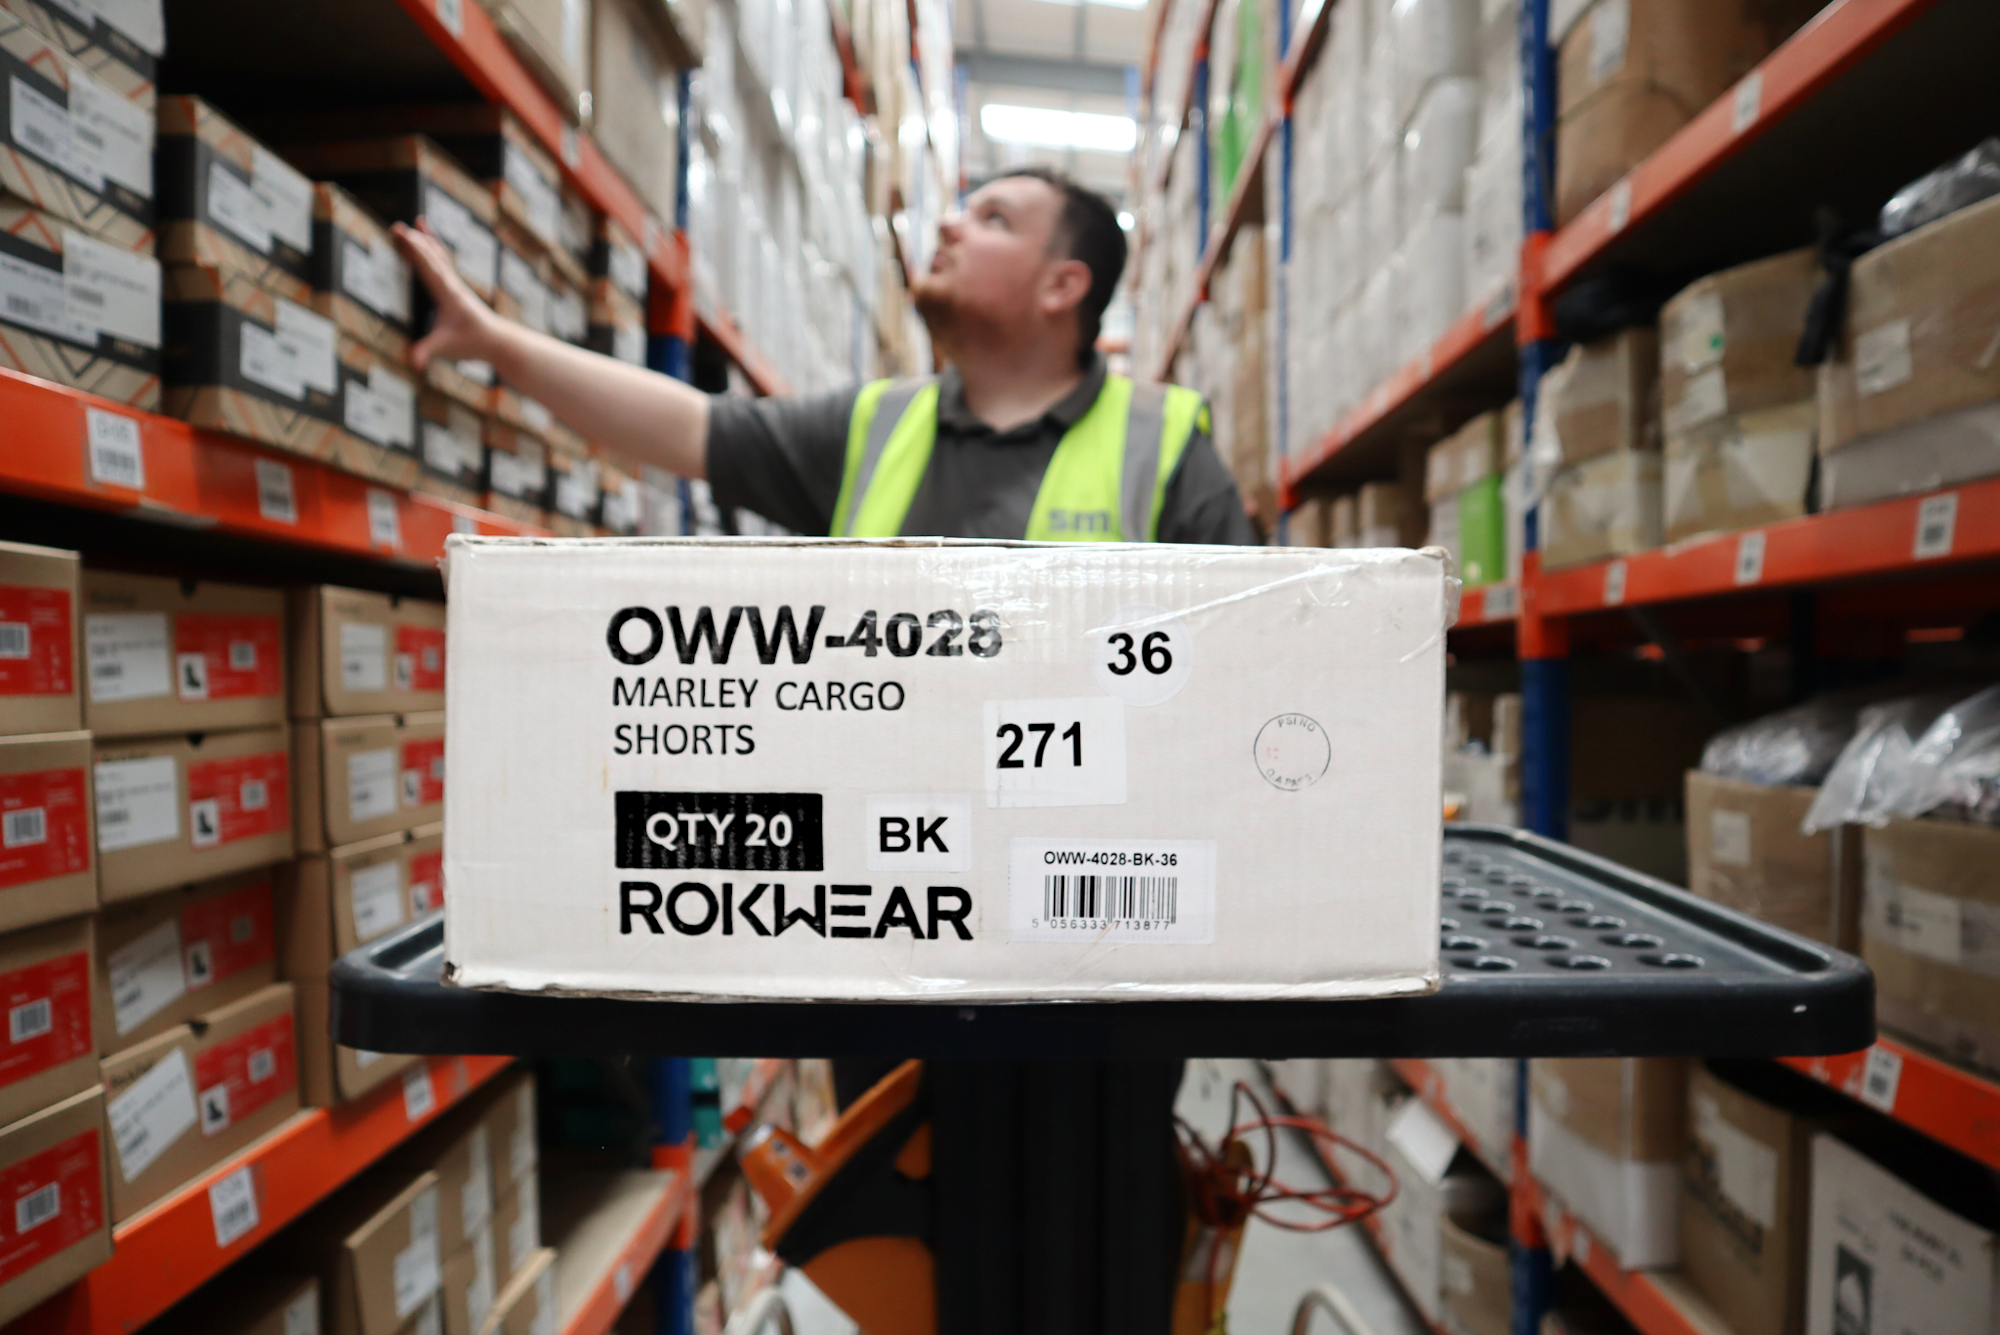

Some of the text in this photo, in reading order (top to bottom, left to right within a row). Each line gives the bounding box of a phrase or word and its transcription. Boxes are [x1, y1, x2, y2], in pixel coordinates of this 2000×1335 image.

[606, 604, 1003, 666] OWW-4028
[1107, 630, 1173, 676] 36
[612, 676, 906, 711] MARLEY CARGO
[613, 724, 756, 755] SHORTS
[996, 721, 1082, 769] 271
[645, 812, 793, 851] QTY 20
[879, 816, 950, 853] BK
[1043, 850, 1178, 867] OWW-4028-BK-36
[619, 881, 974, 941] ROKWEAR
